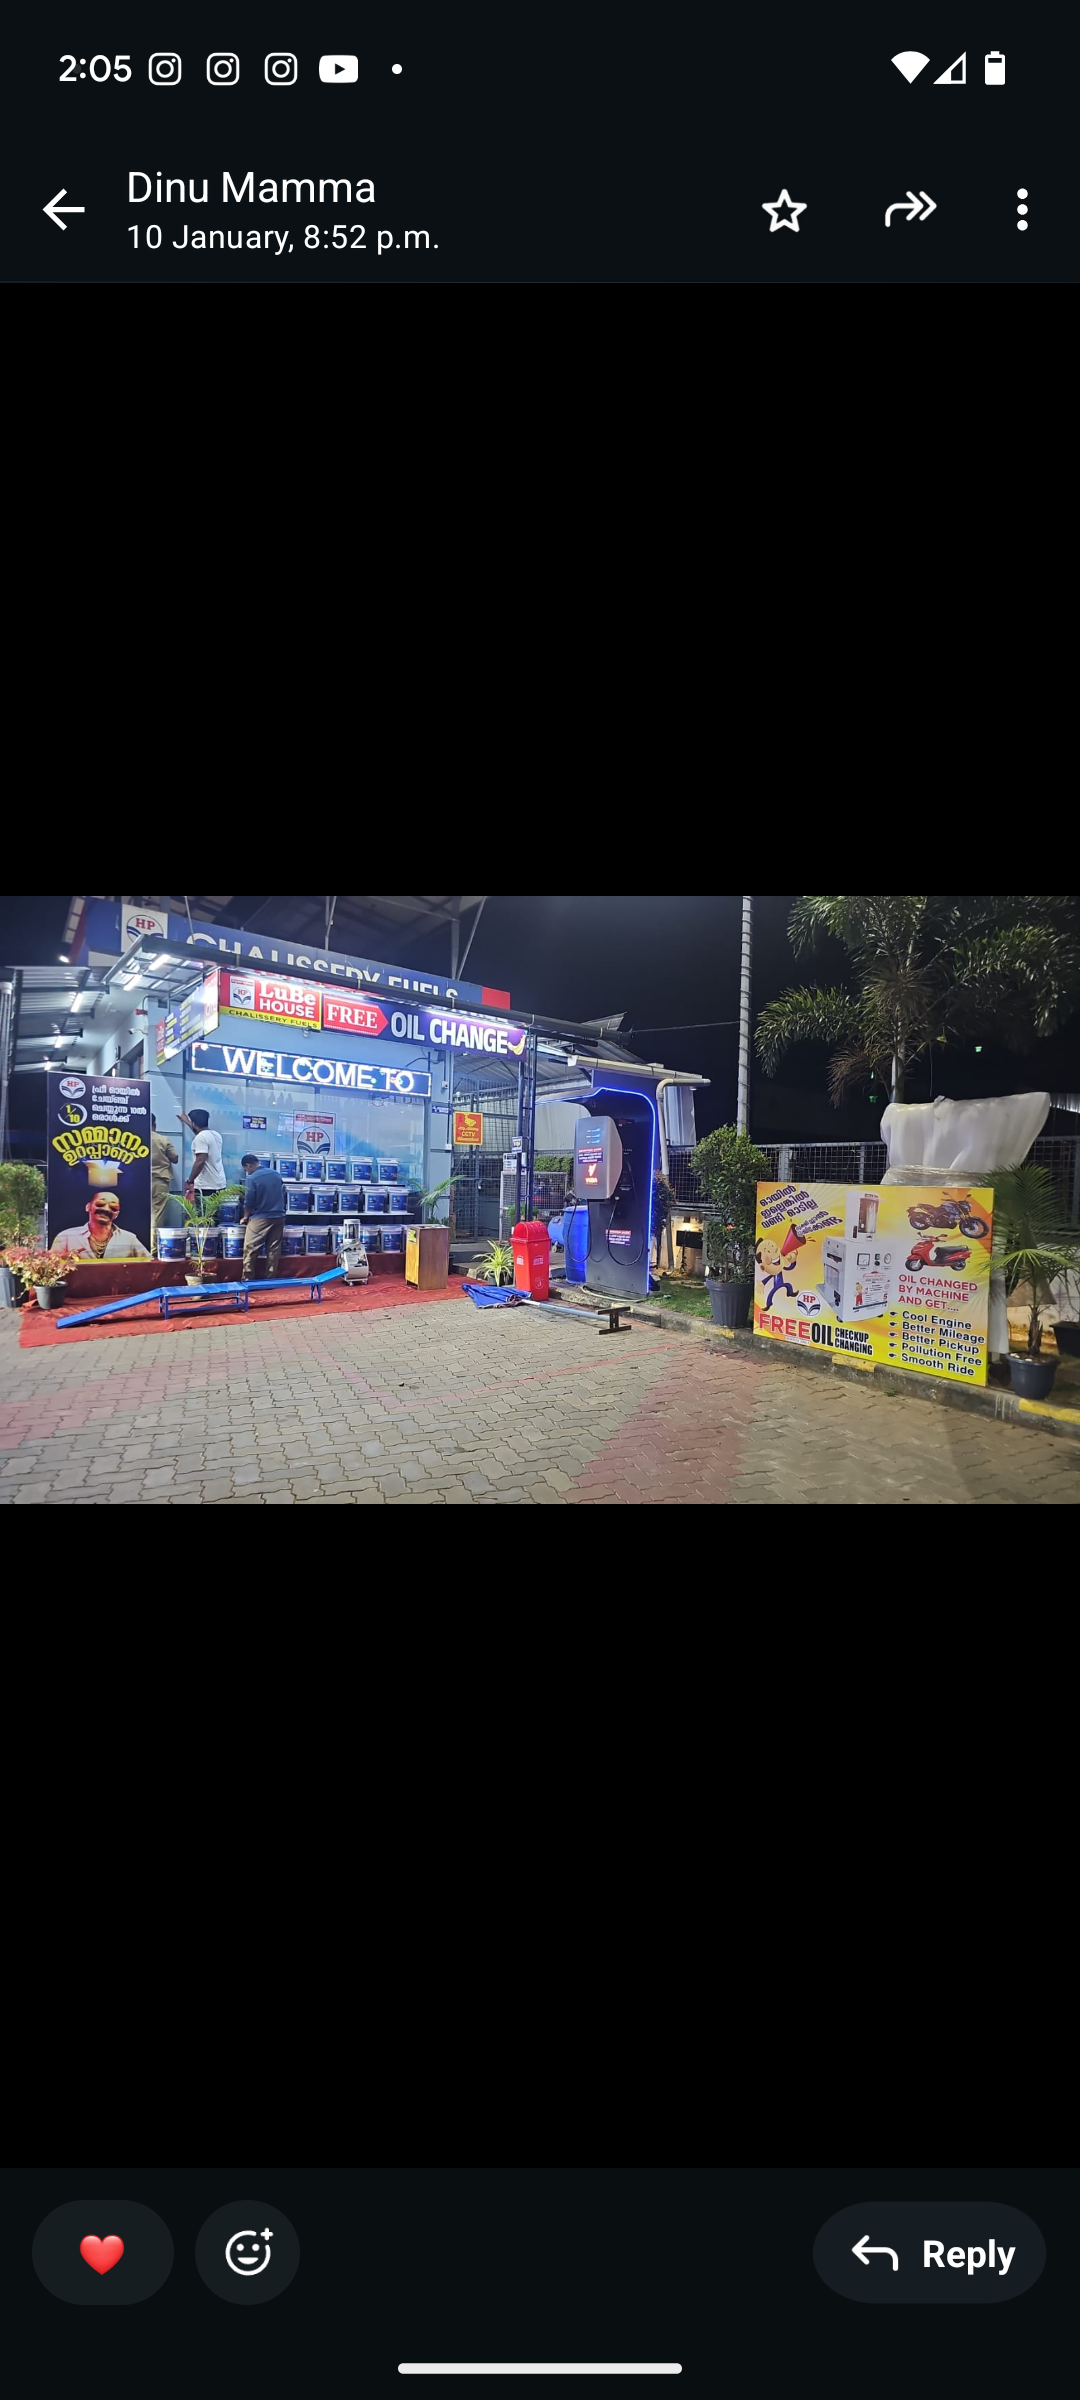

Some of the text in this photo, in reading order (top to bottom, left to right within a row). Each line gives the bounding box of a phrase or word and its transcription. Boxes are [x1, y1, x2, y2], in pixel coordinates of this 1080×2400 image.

[135, 917, 155, 930] HP
[260, 999, 315, 1018] HOUSE
[229, 1010, 287, 1023] CHALISSERY
[290, 1019, 318, 1028] FUELS
[326, 1003, 509, 1054] FREE OIL CHANGE
[223, 1046, 415, 1092] WELCOME TO
[52, 1126, 150, 1158] സമ്മാനം
[306, 1132, 324, 1142] HP
[62, 1144, 139, 1167] ഉറപ്പാണ്
[760, 1185, 796, 1207] ഓയിൽ
[898, 1274, 978, 1291] OIL CHANGED
[803, 1295, 816, 1304] HP
[898, 1285, 969, 1301] BY MACHINE
[898, 1295, 922, 1306] AND
[760, 1313, 810, 1339] FREE
[812, 1323, 833, 1346] OIL
[902, 1311, 972, 1330] Cool Engine
[835, 1327, 869, 1343] CHECKUP
[902, 1322, 985, 1344] Better Mileage
[835, 1338, 873, 1355] CHANGING
[902, 1332, 979, 1355] Better Pickup
[902, 1342, 982, 1366] Pollution Free
[902, 1353, 974, 1376] Smooth Ride
